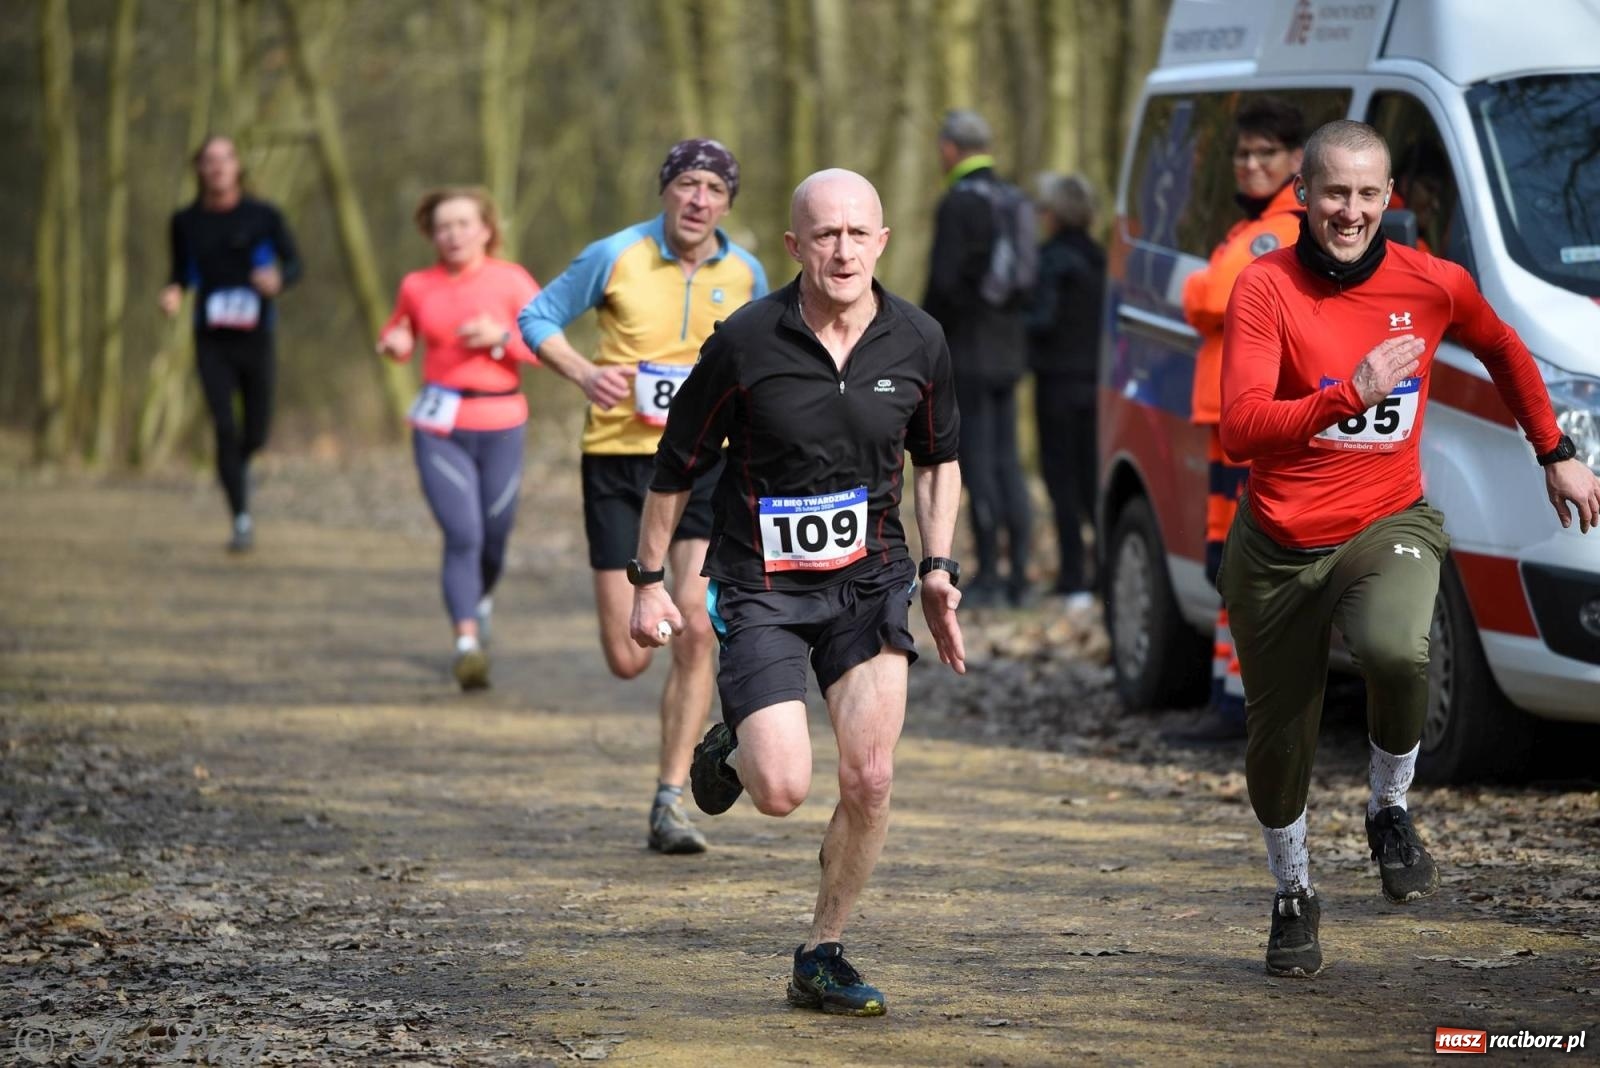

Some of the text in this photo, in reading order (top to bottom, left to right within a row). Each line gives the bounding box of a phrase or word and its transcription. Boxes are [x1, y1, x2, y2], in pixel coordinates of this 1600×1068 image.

[653, 379, 675, 410] 8
[772, 491, 856, 507] XII BIEG TWARDZIELA
[773, 509, 858, 553] 109
